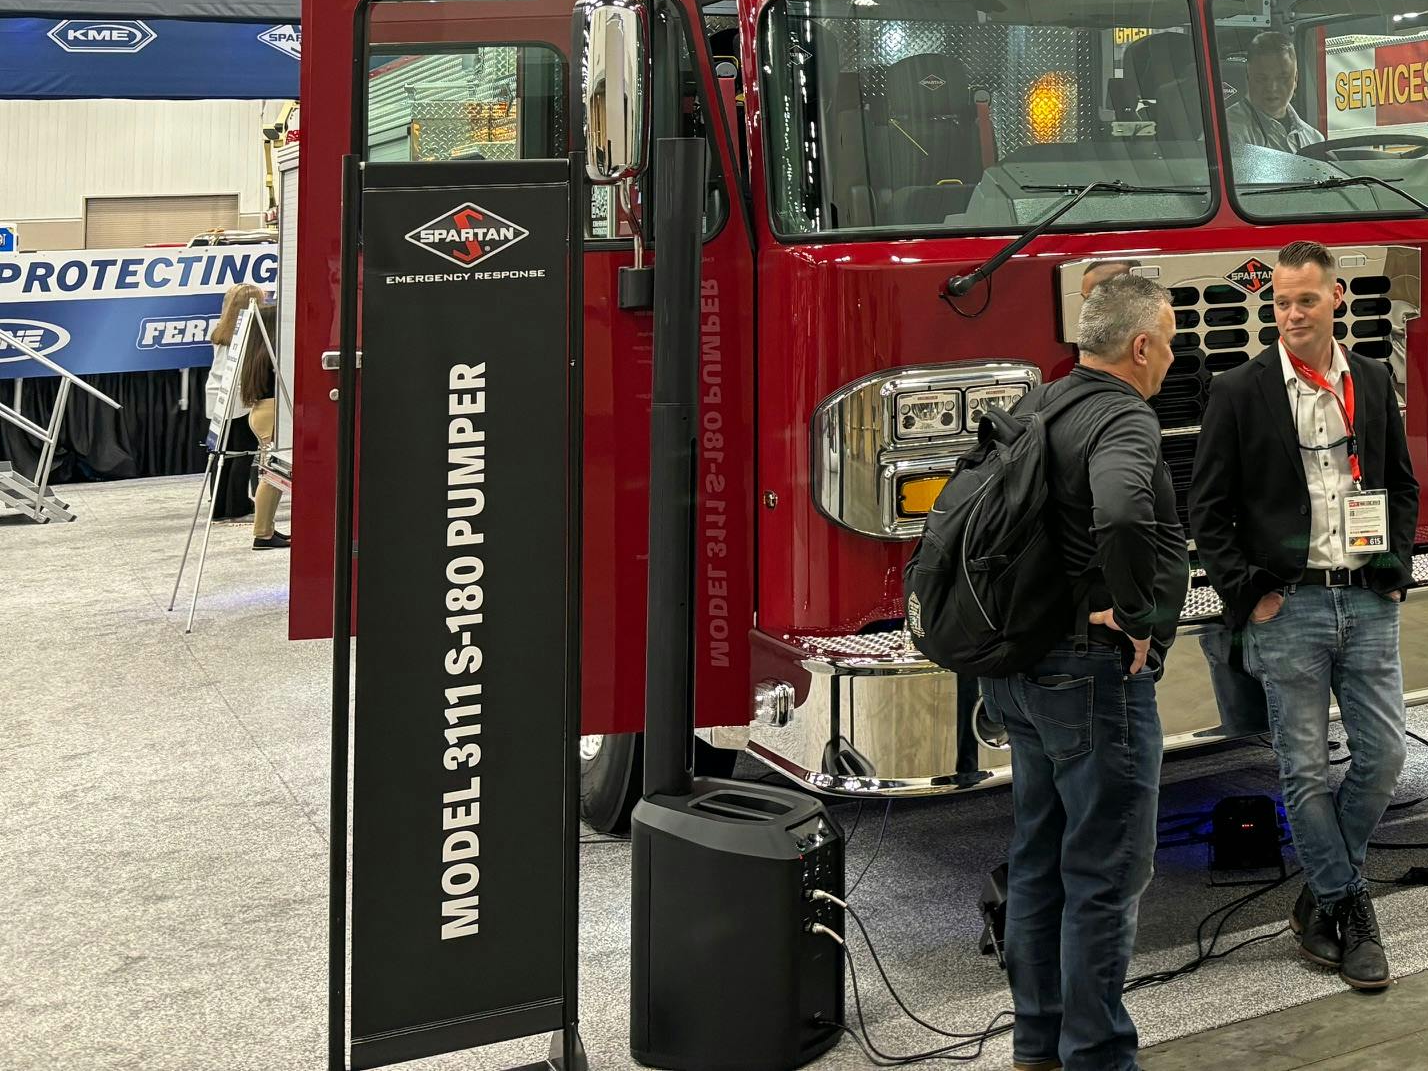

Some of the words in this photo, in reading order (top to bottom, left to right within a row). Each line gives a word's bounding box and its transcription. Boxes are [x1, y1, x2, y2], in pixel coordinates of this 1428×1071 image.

[67, 28, 131, 42] KME
[419, 226, 515, 244] SPARTAN
[0, 254, 278, 293] PROTECTING
[385, 272, 472, 285] EMERGENCY
[474, 269, 546, 281] RESPONSE
[447, 361, 487, 547] PUMPER
[445, 555, 484, 675] S-180
[443, 685, 482, 771] 3111
[441, 777, 480, 940] MODEL
